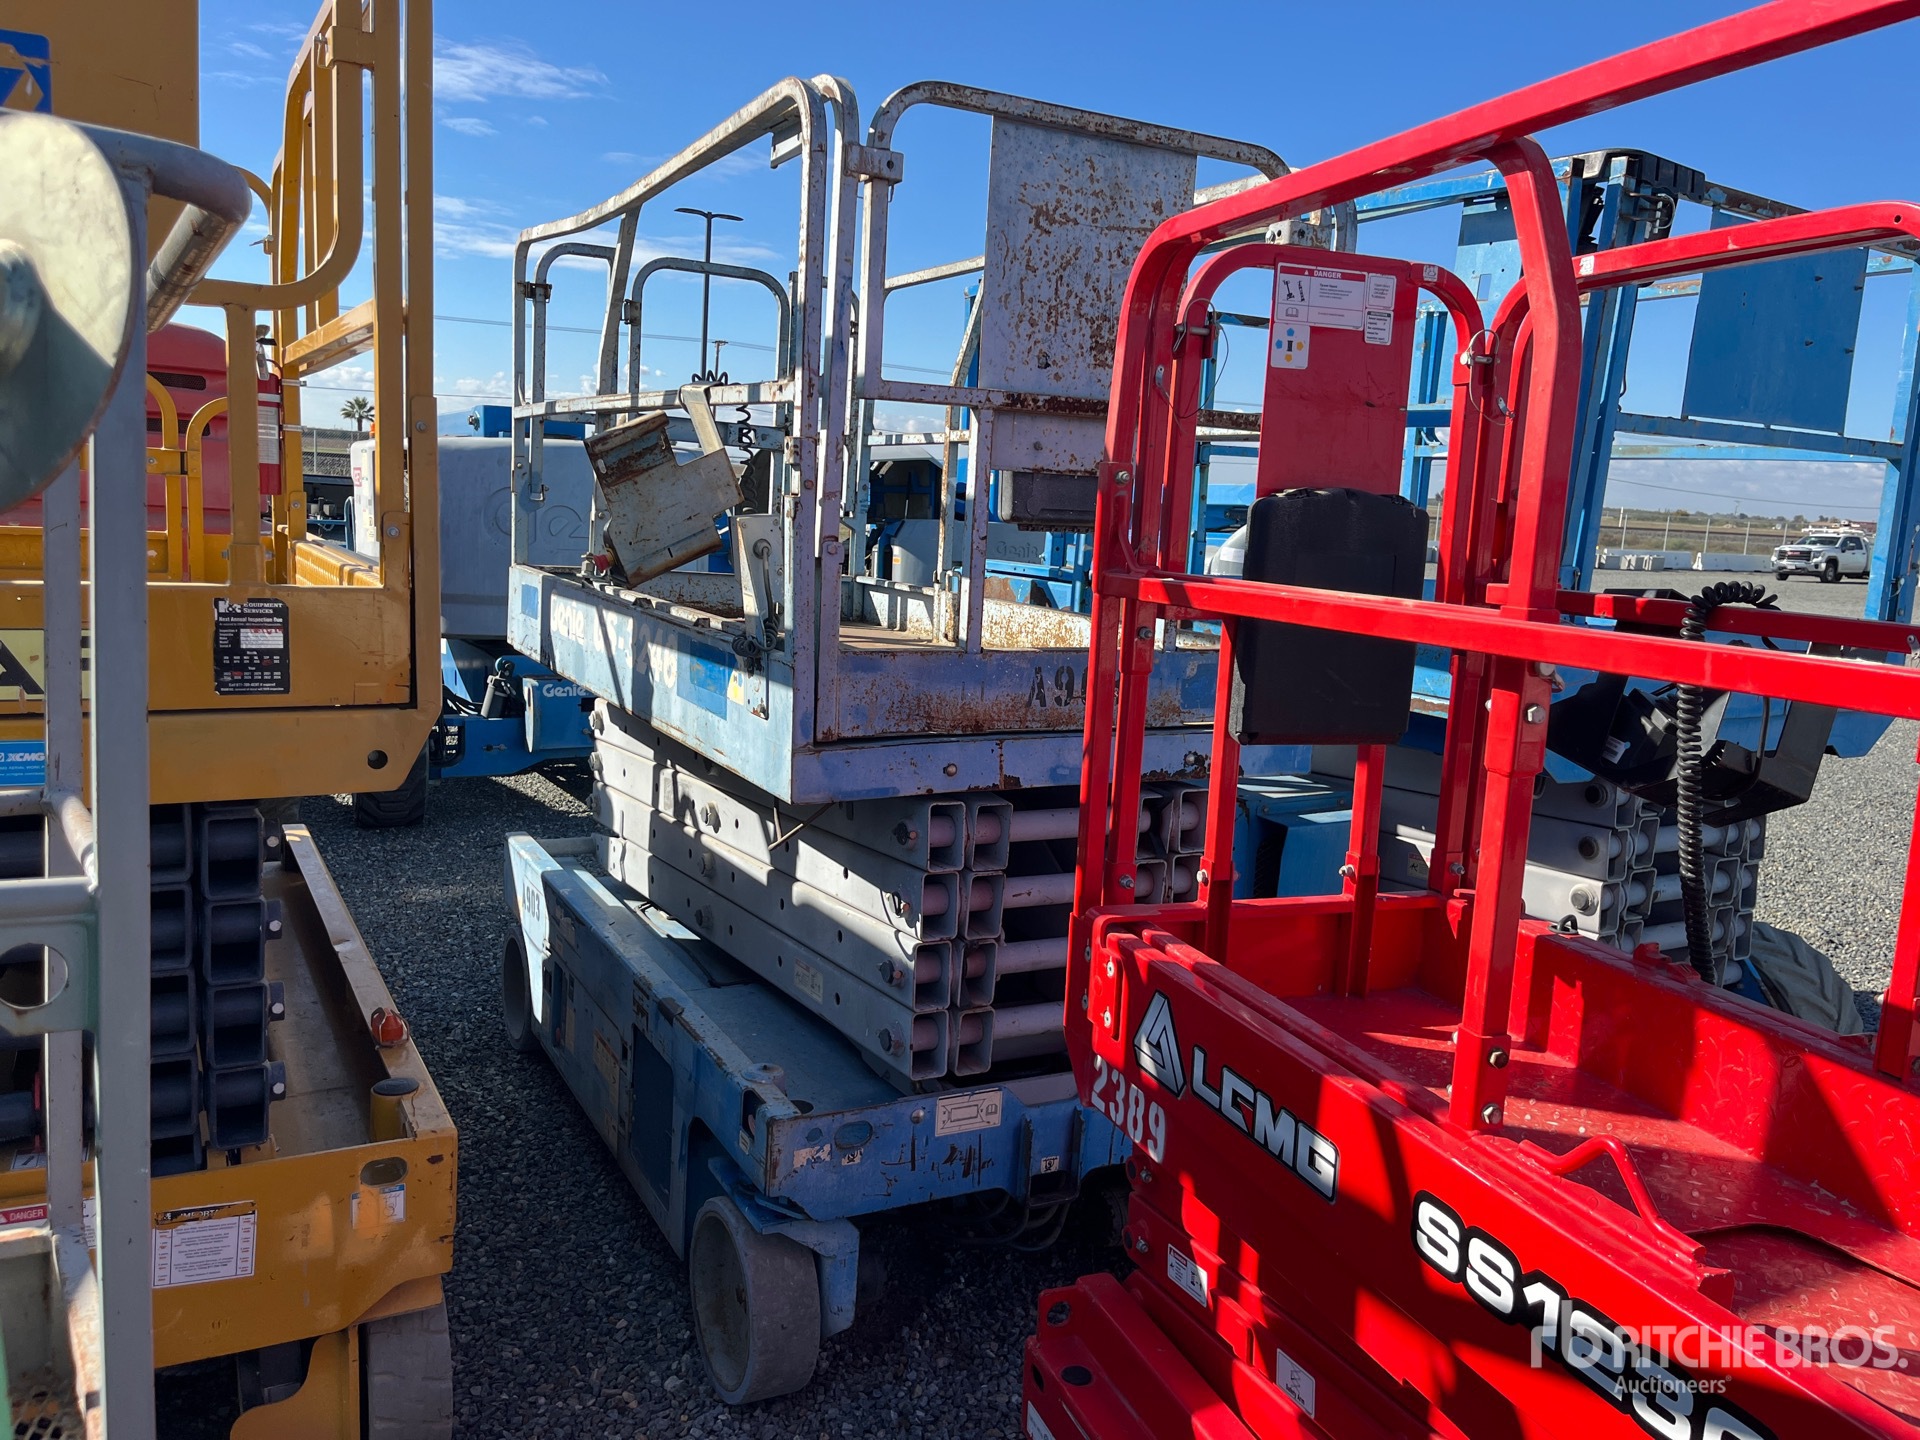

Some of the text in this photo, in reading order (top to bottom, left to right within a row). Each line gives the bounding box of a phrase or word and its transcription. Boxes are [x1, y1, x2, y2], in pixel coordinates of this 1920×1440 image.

[1313, 270, 1342, 280] DANGER
[996, 541, 1038, 558] Genie
[542, 683, 587, 697] Genie
[6, 753, 46, 762] XCMG
[522, 882, 541, 922] A903
[1090, 1055, 1167, 1163] 2389
[9, 1208, 44, 1221] DANGER
